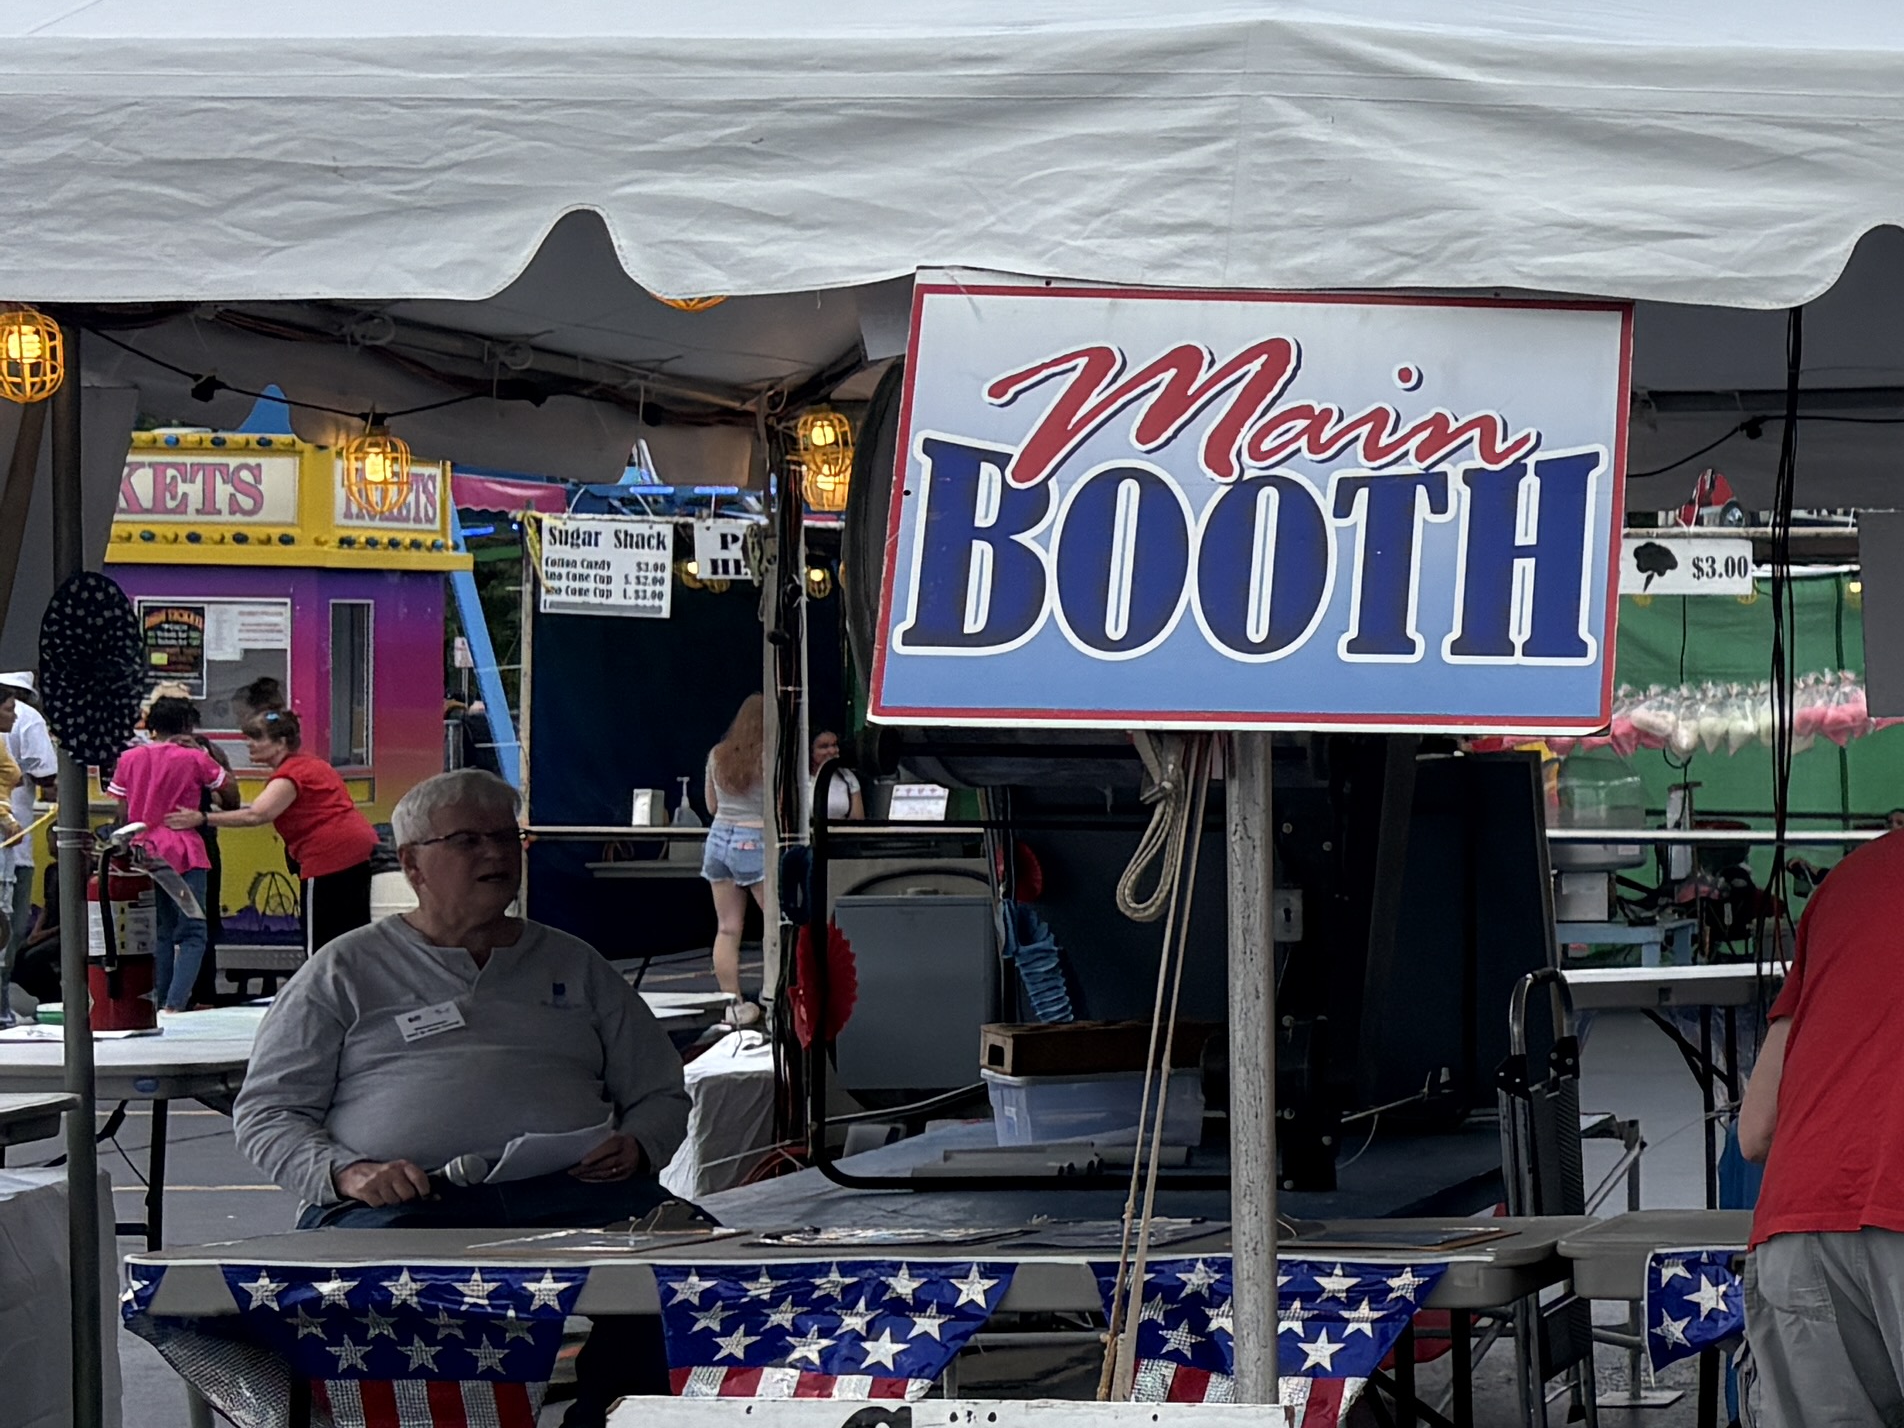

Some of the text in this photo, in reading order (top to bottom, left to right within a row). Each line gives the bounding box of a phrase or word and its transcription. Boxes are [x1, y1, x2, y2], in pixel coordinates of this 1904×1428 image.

[985, 336, 1541, 485] Main
[548, 526, 667, 551] Sugar Shack
[899, 433, 1606, 661] BOOTH
[545, 556, 577, 568] Cotton
[581, 558, 611, 572] Candy
[1692, 555, 1749, 580] $3.00
[566, 571, 591, 583] Cone
[594, 573, 613, 585] Cup
[565, 585, 590, 597] Cone
[594, 588, 613, 599] Cup
